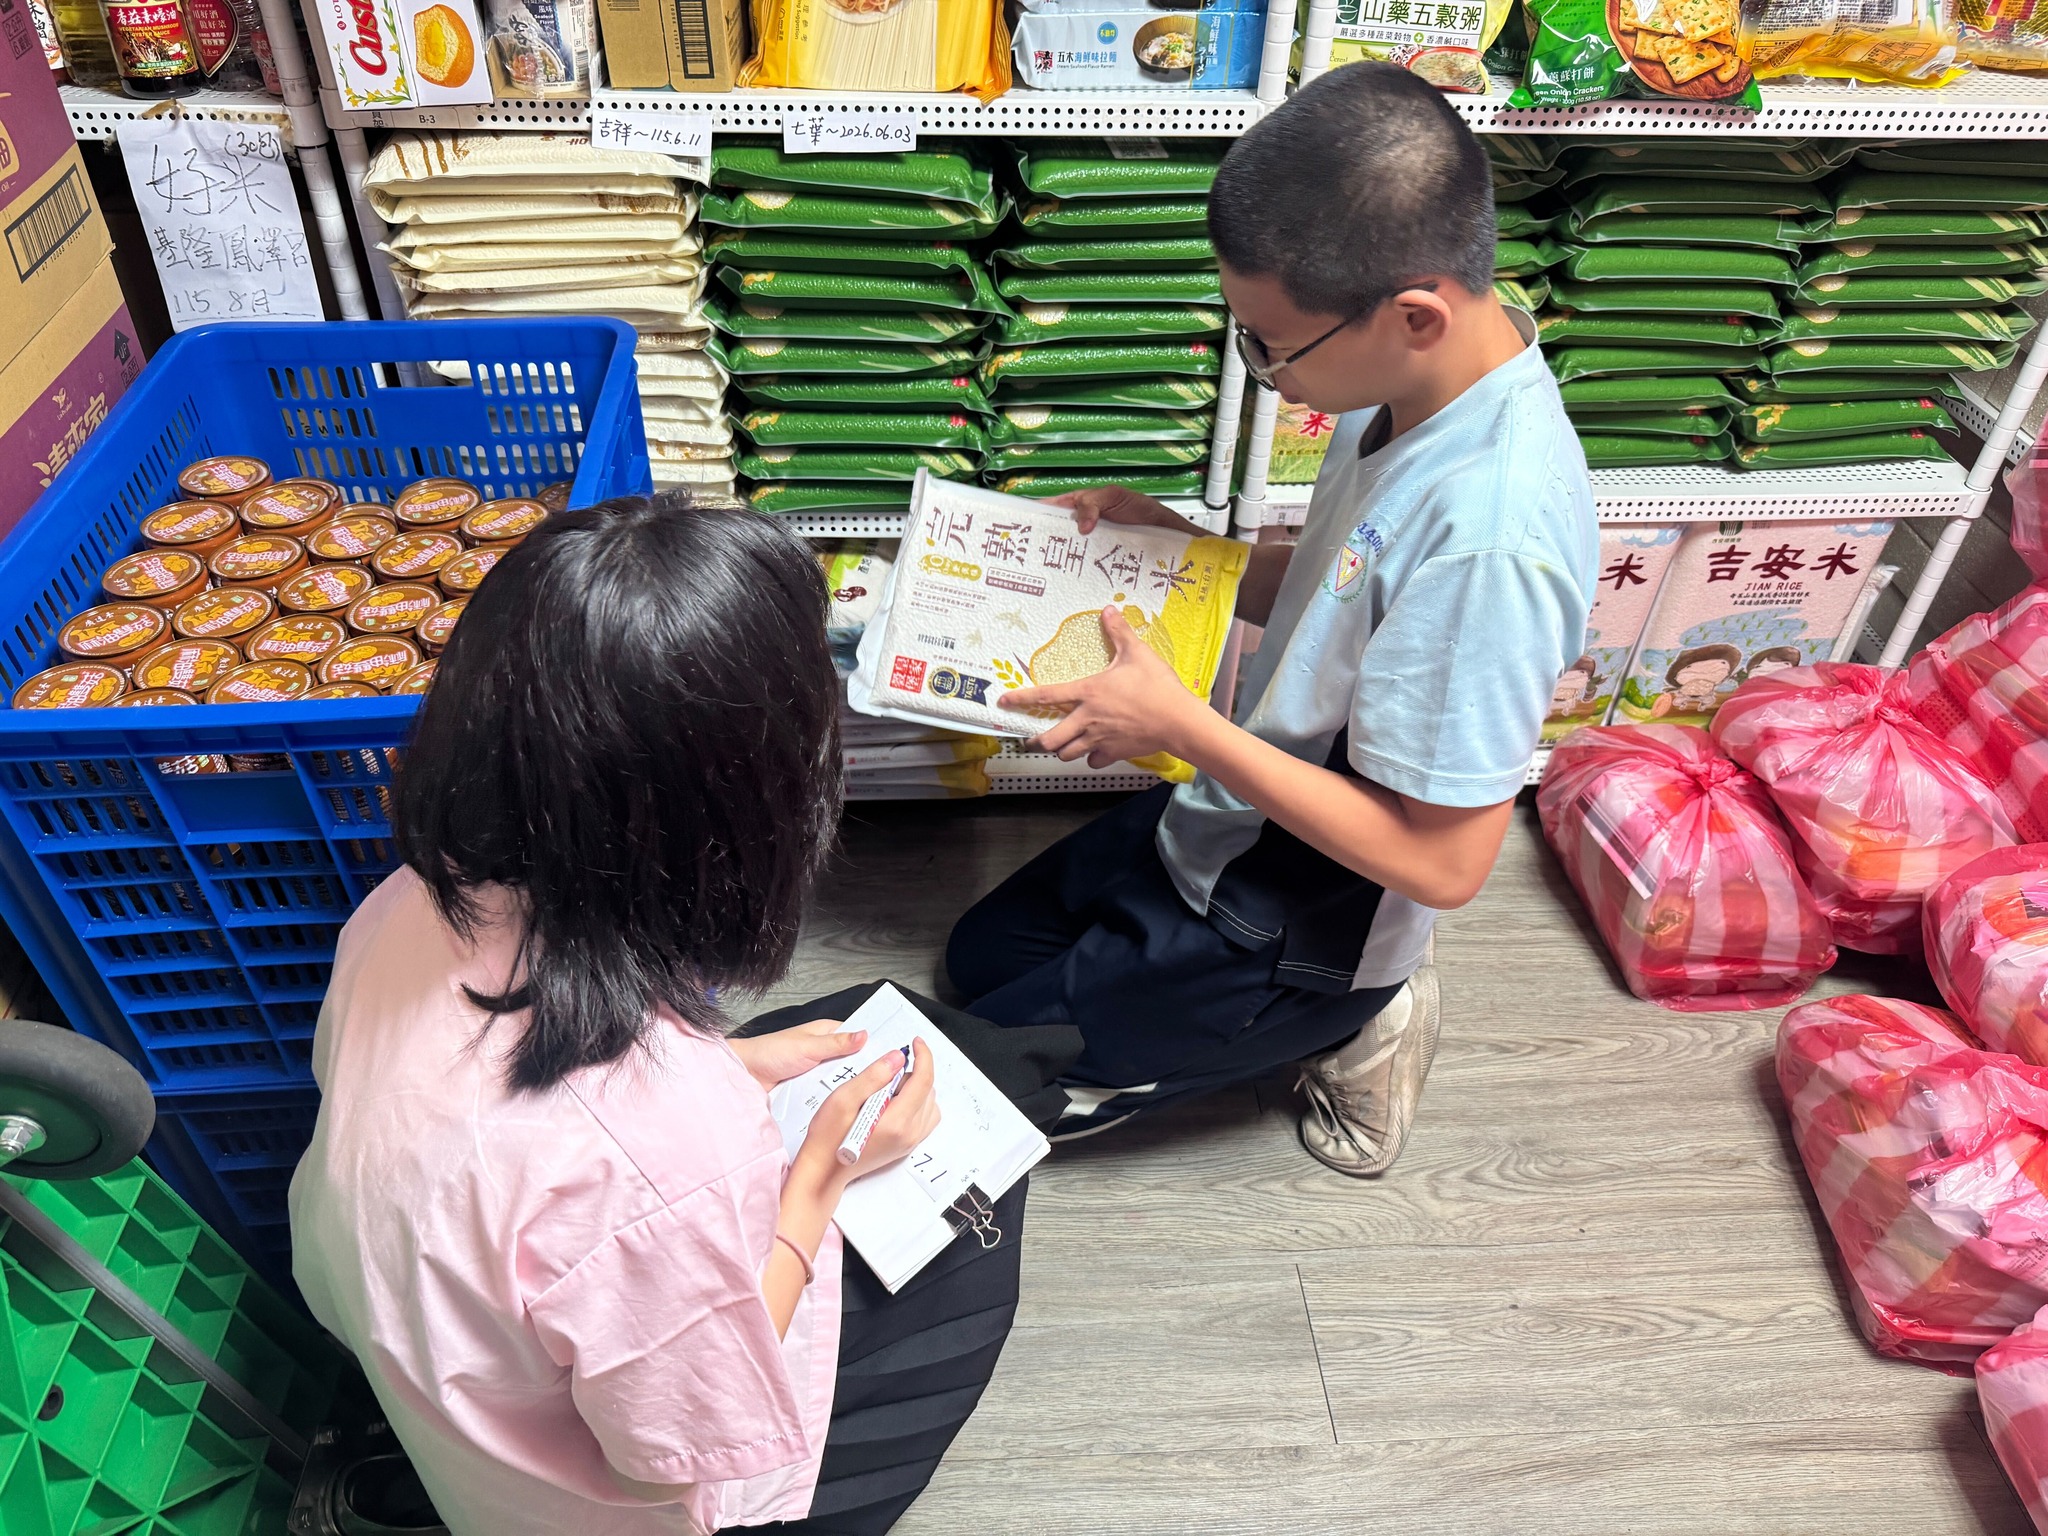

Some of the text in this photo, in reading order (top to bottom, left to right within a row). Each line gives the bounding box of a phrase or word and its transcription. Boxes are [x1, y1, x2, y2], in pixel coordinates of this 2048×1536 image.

[117, 9, 177, 25] 香菇素蠔油
[1363, 0, 1482, 31] 山藥五穀粥
[1340, 27, 1412, 42] 嚴選多種蔬菜穀物
[1057, 51, 1117, 63] 五木海鮮味拉麵
[1550, 88, 1572, 96] Onion
[1573, 86, 1604, 95] Crackers
[418, 115, 436, 124] B-3
[146, 144, 283, 215] 好米
[1300, 411, 1334, 438] 米
[1706, 542, 1861, 583] 吉安米
[1599, 553, 1649, 590] 米
[1744, 581, 1804, 591] JIAN RICE
